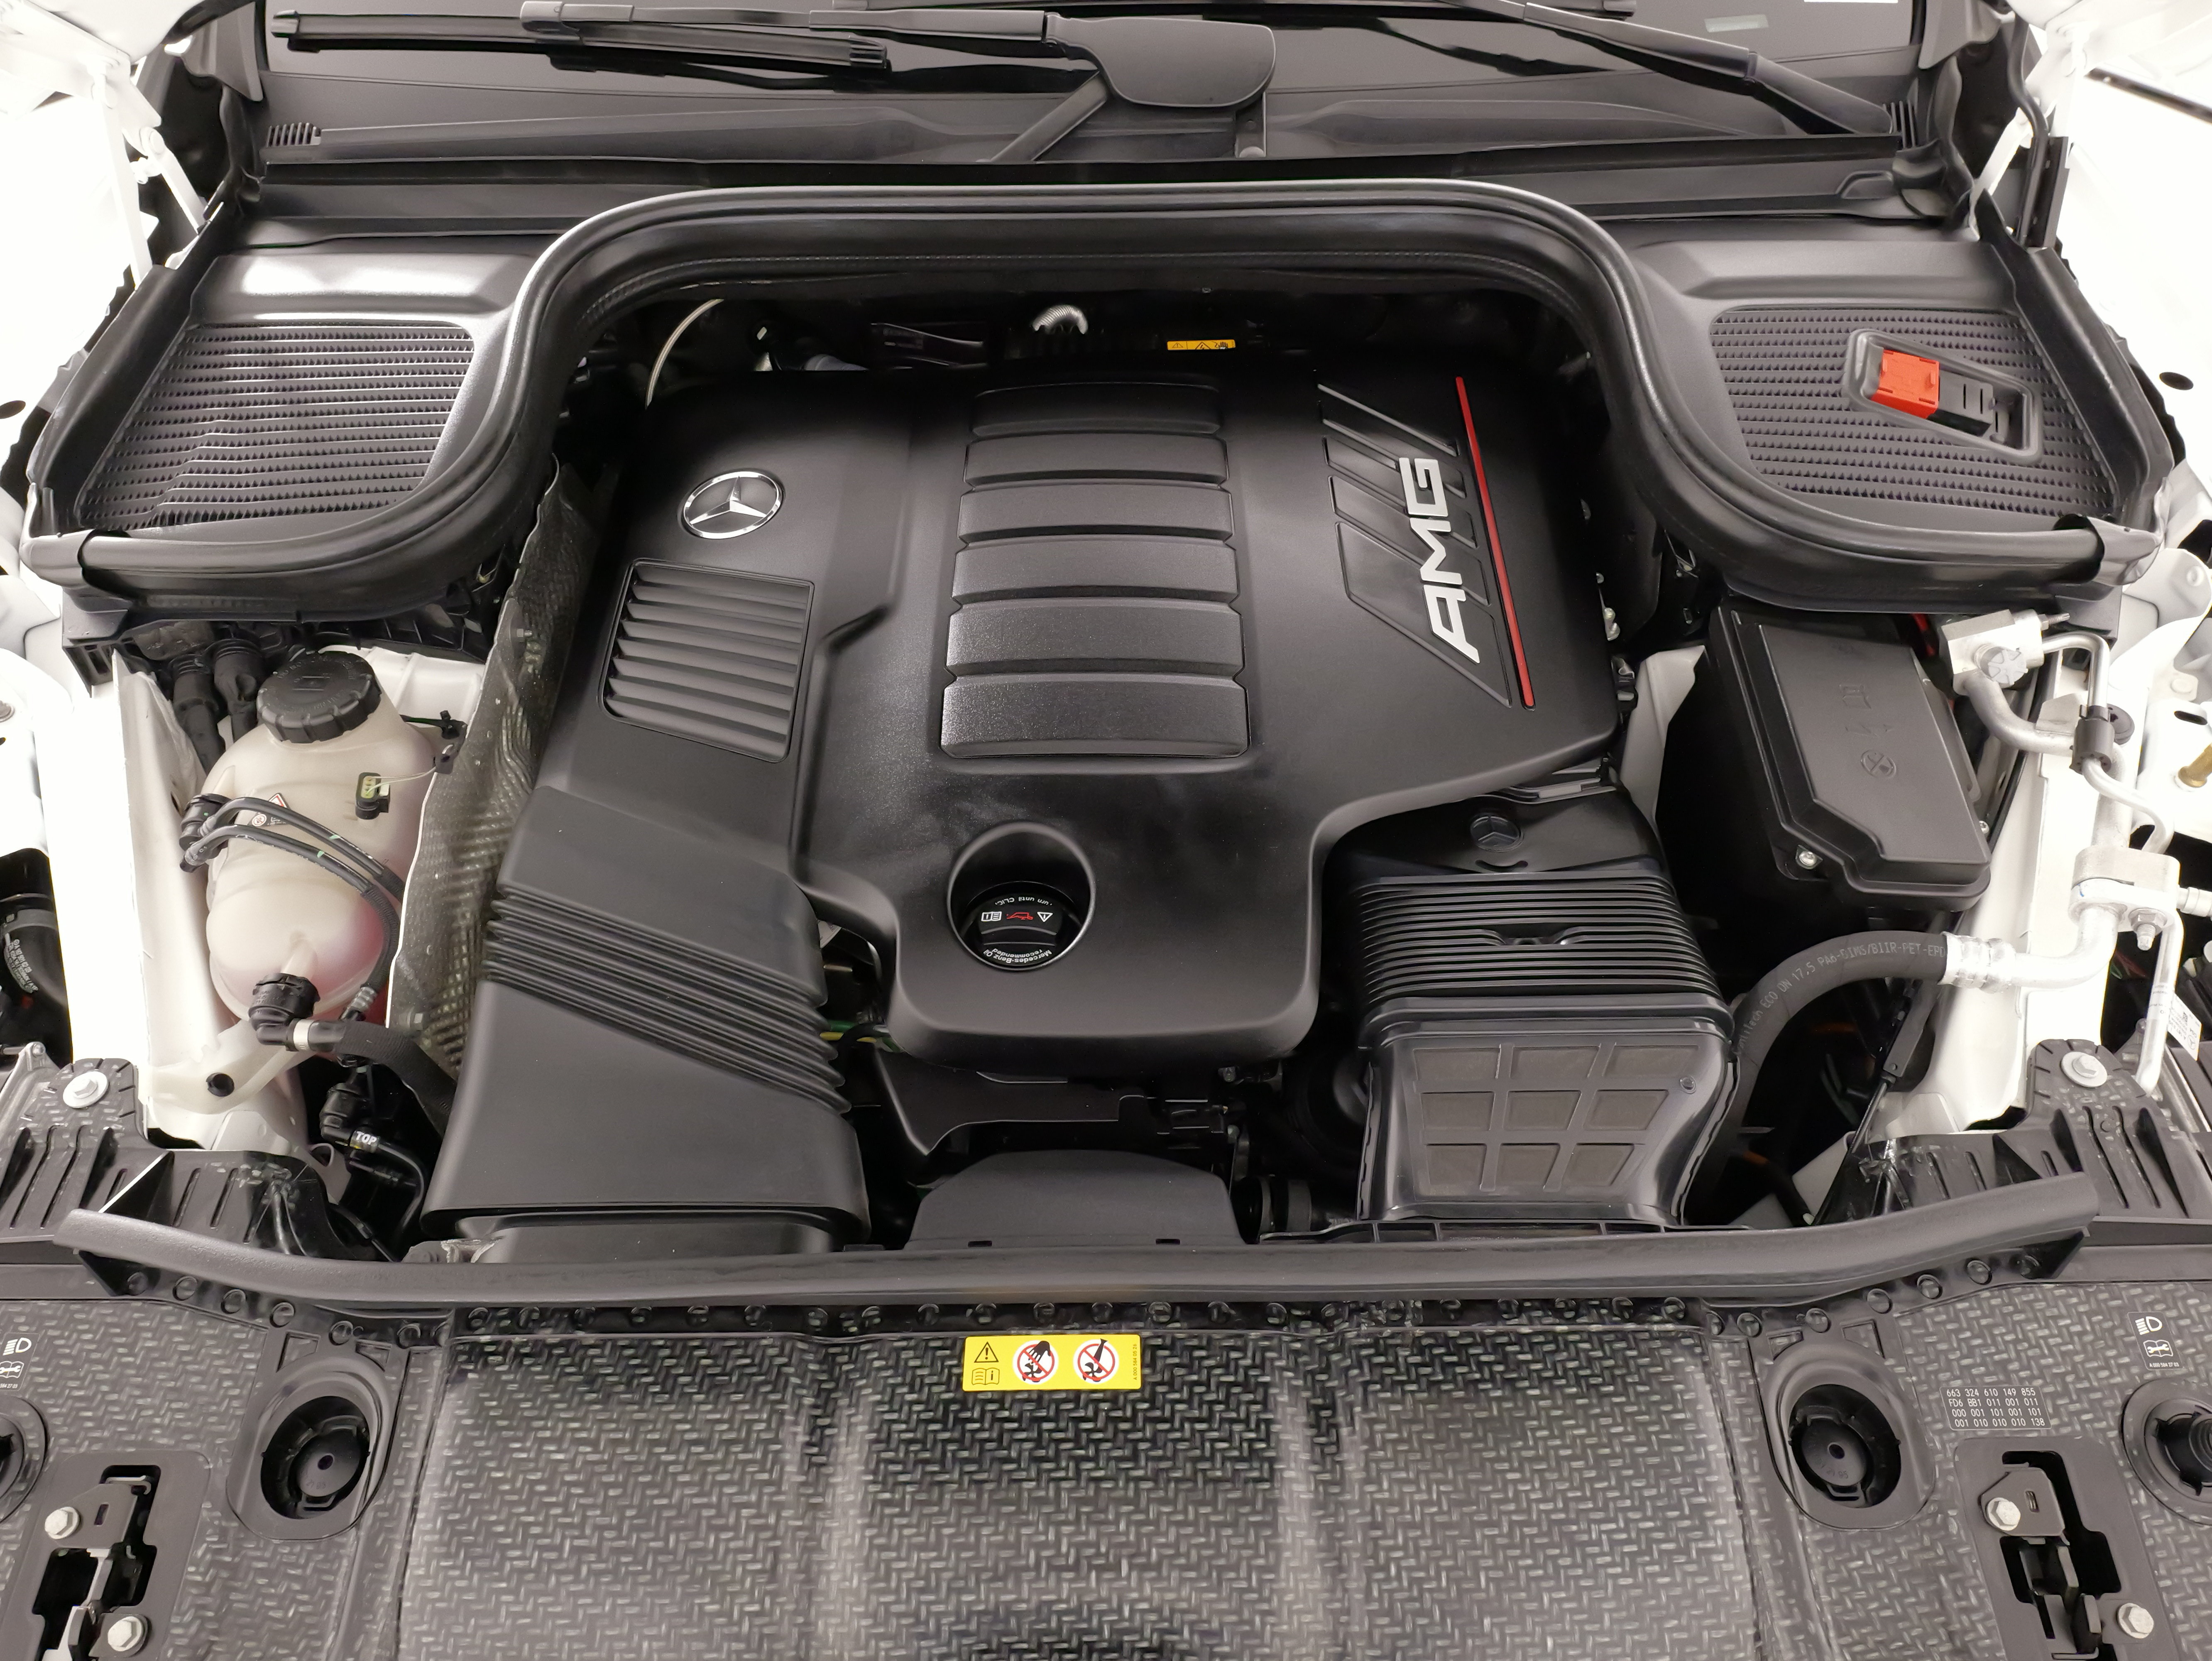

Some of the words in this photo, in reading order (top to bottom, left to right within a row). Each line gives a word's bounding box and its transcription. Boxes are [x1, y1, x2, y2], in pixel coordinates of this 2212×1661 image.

[1399, 458, 1480, 663] AMG
[995, 897, 1015, 906] CLIC
[992, 948, 1042, 958] recommended
[993, 950, 1052, 963] Mercedes-Benz
[1759, 992, 1778, 1008] ECO
[1777, 979, 1792, 992] DN
[1792, 961, 1815, 981] 17,5
[356, 1131, 377, 1145] TOP
[1947, 1389, 1960, 1397] 663
[1984, 1388, 1998, 1396] 610
[1948, 1399, 1963, 1407] FD6
[1987, 1398, 2000, 1406] 011
[1970, 1409, 1985, 1417] 001
[1955, 1419, 1969, 1427] 001
[1973, 1418, 1988, 1427] 010
[1992, 1418, 2007, 1427] 010
[2011, 1418, 2026, 1426] 010
